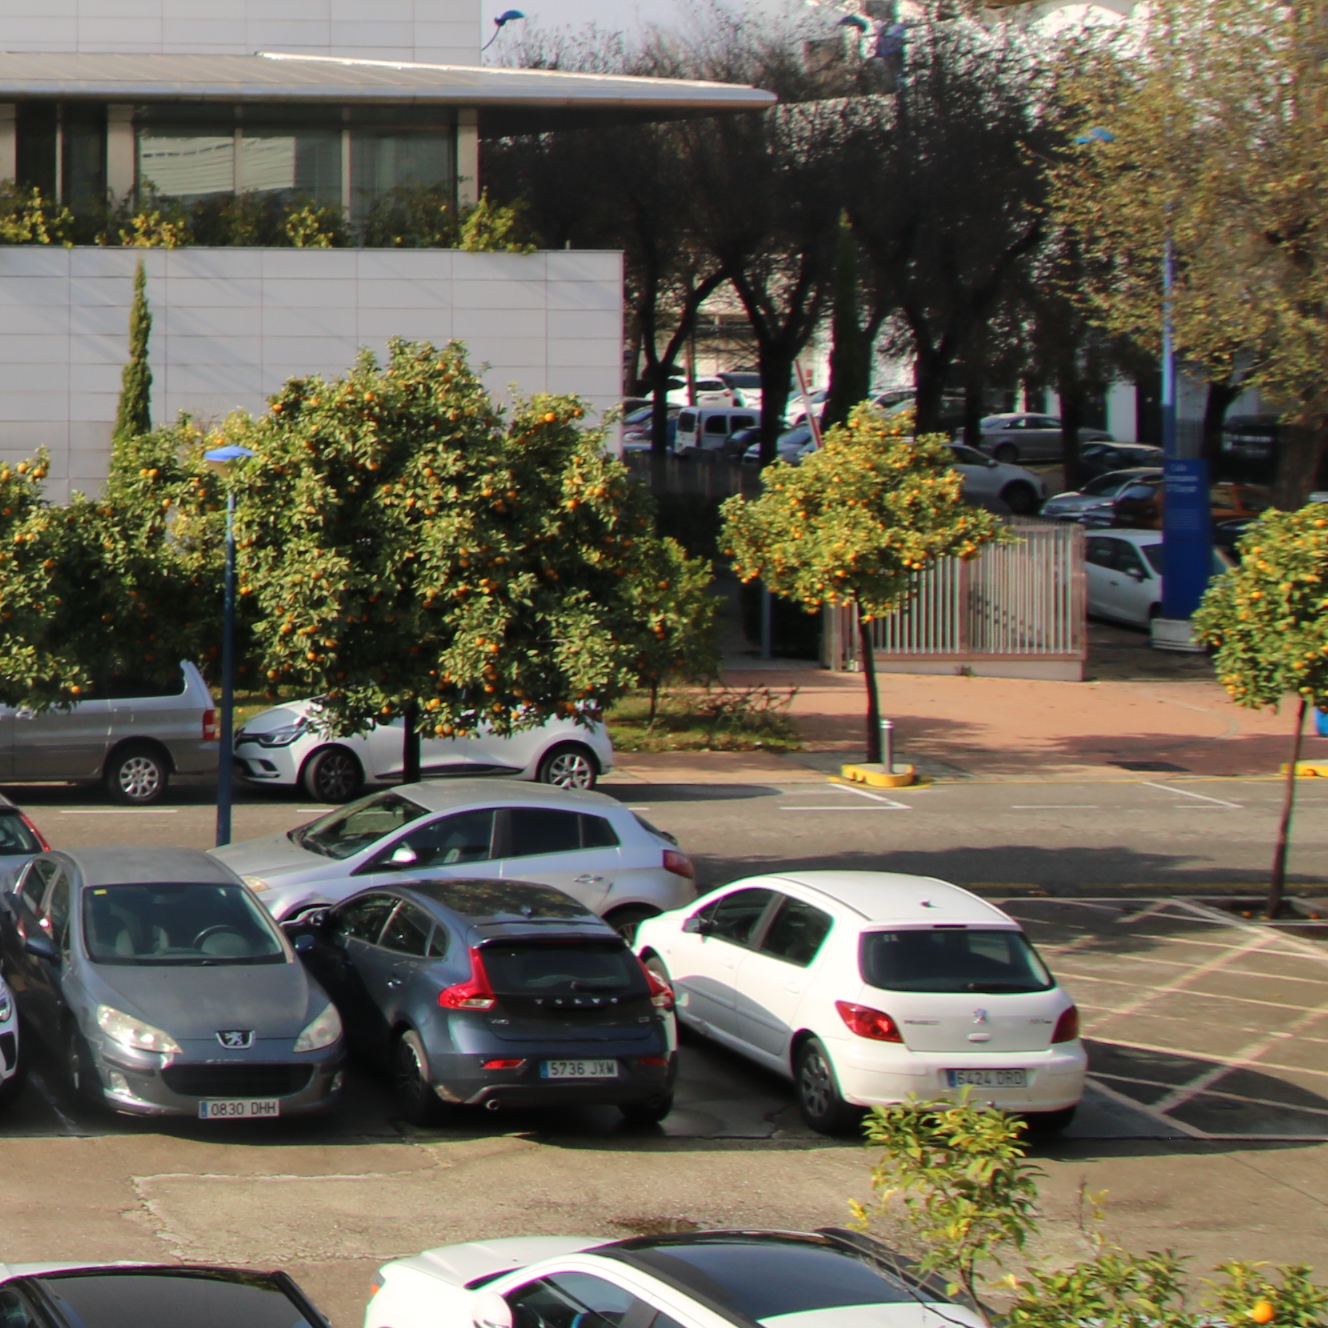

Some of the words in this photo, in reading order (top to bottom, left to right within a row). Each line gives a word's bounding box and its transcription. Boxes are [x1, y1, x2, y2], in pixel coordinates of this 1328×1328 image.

[550, 1062, 585, 1076] 5736
[957, 1072, 992, 1085] 6424
[211, 1102, 244, 1116] 0830
[251, 1101, 276, 1115] DHH
